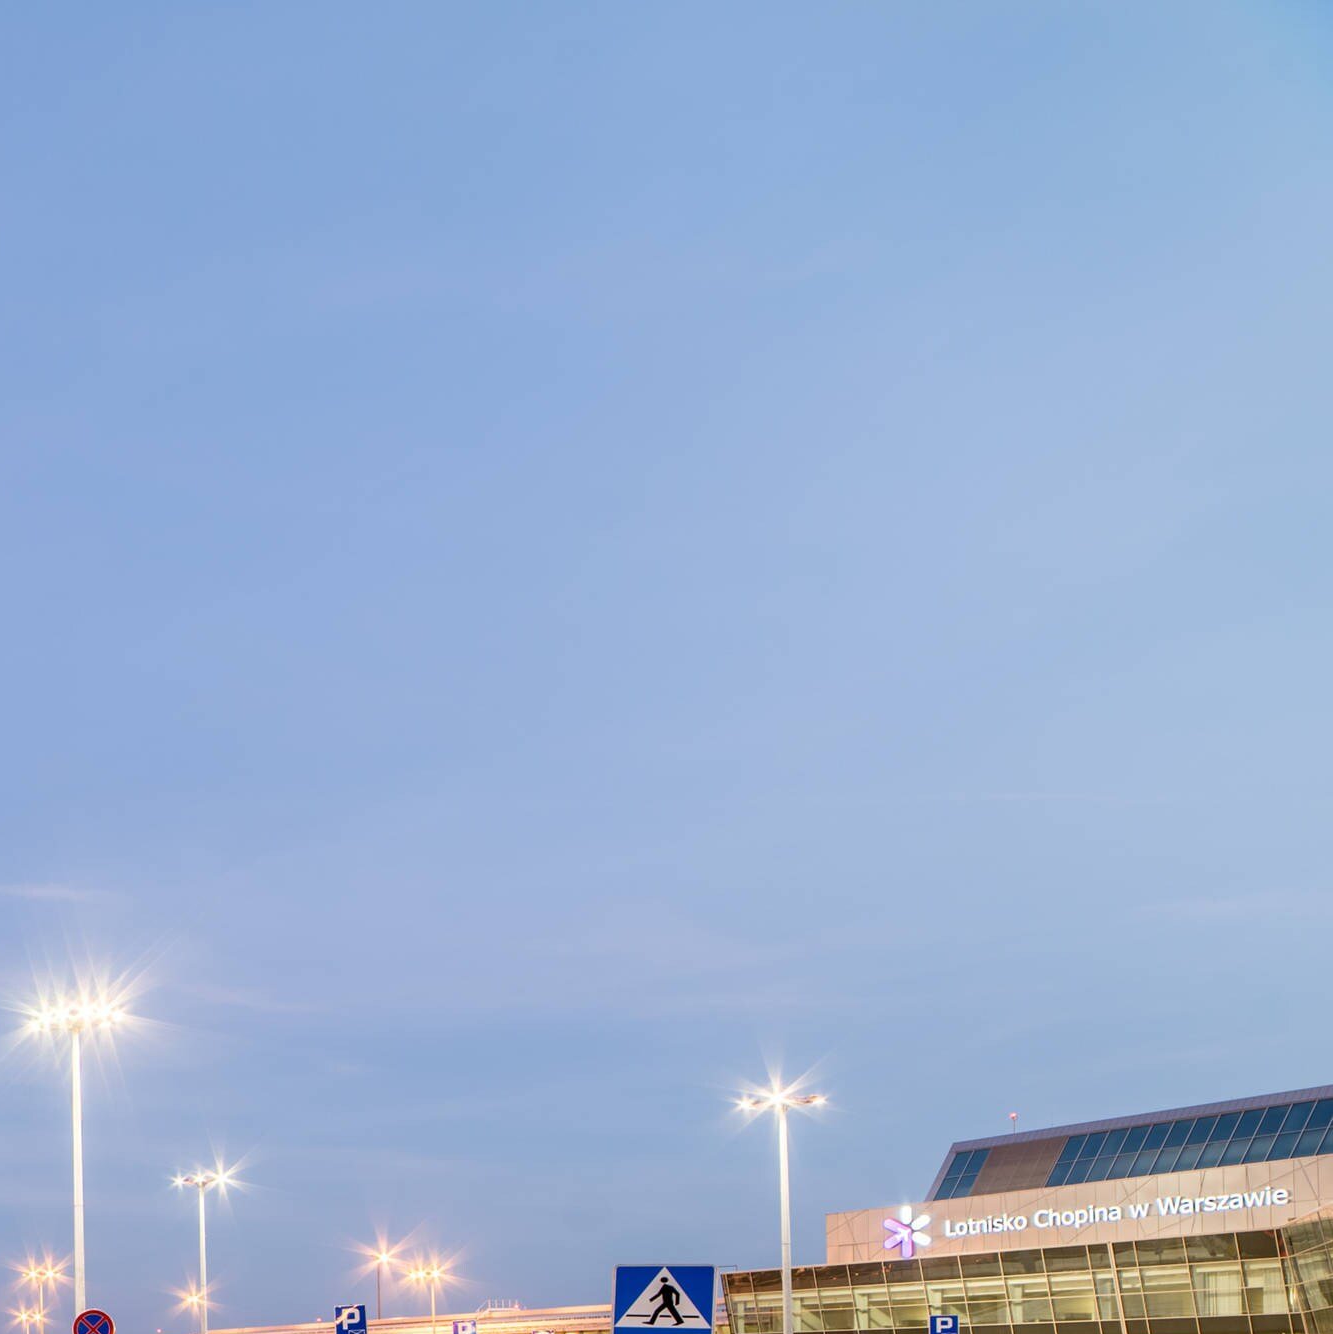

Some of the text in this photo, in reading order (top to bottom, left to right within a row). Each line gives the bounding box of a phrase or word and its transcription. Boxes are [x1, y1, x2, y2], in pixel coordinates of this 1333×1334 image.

[944, 1186, 1289, 1238] Lotnisko Chopina w Warszawie
[343, 1308, 361, 1331] P
[936, 1317, 954, 1334] P
